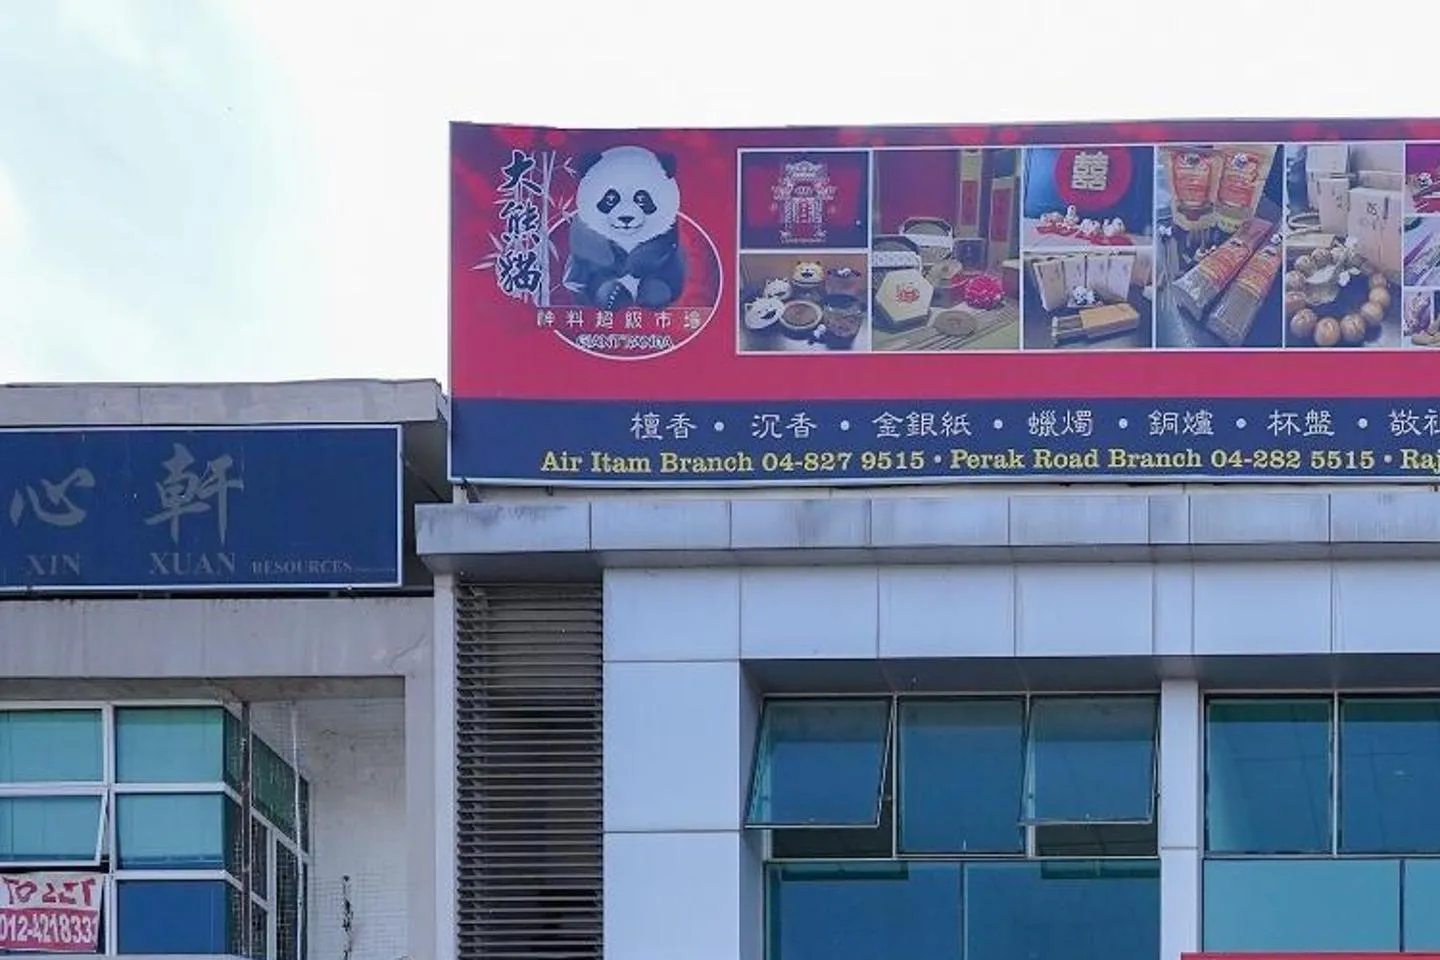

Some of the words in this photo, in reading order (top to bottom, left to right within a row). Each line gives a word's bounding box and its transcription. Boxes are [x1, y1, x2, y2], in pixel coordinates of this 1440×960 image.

[630, 411, 698, 440] 檀香
[751, 412, 818, 440] 沉香
[871, 411, 972, 439] 金銀紙
[1266, 408, 1335, 437] 杯盤
[541, 451, 583, 471] Air
[590, 450, 651, 473] Itam
[659, 450, 755, 472] Branch
[761, 450, 852, 471] 04-827
[860, 450, 926, 470] 9515
[949, 448, 1025, 469] Perak
[1032, 448, 1099, 468] Road
[1107, 448, 1202, 469] Branch
[1210, 448, 1301, 469] 04-282
[1310, 448, 1376, 469] 5515
[27, 554, 81, 577] XIN
[149, 551, 237, 576] XUAN
[251, 559, 354, 574] RESOURCES
